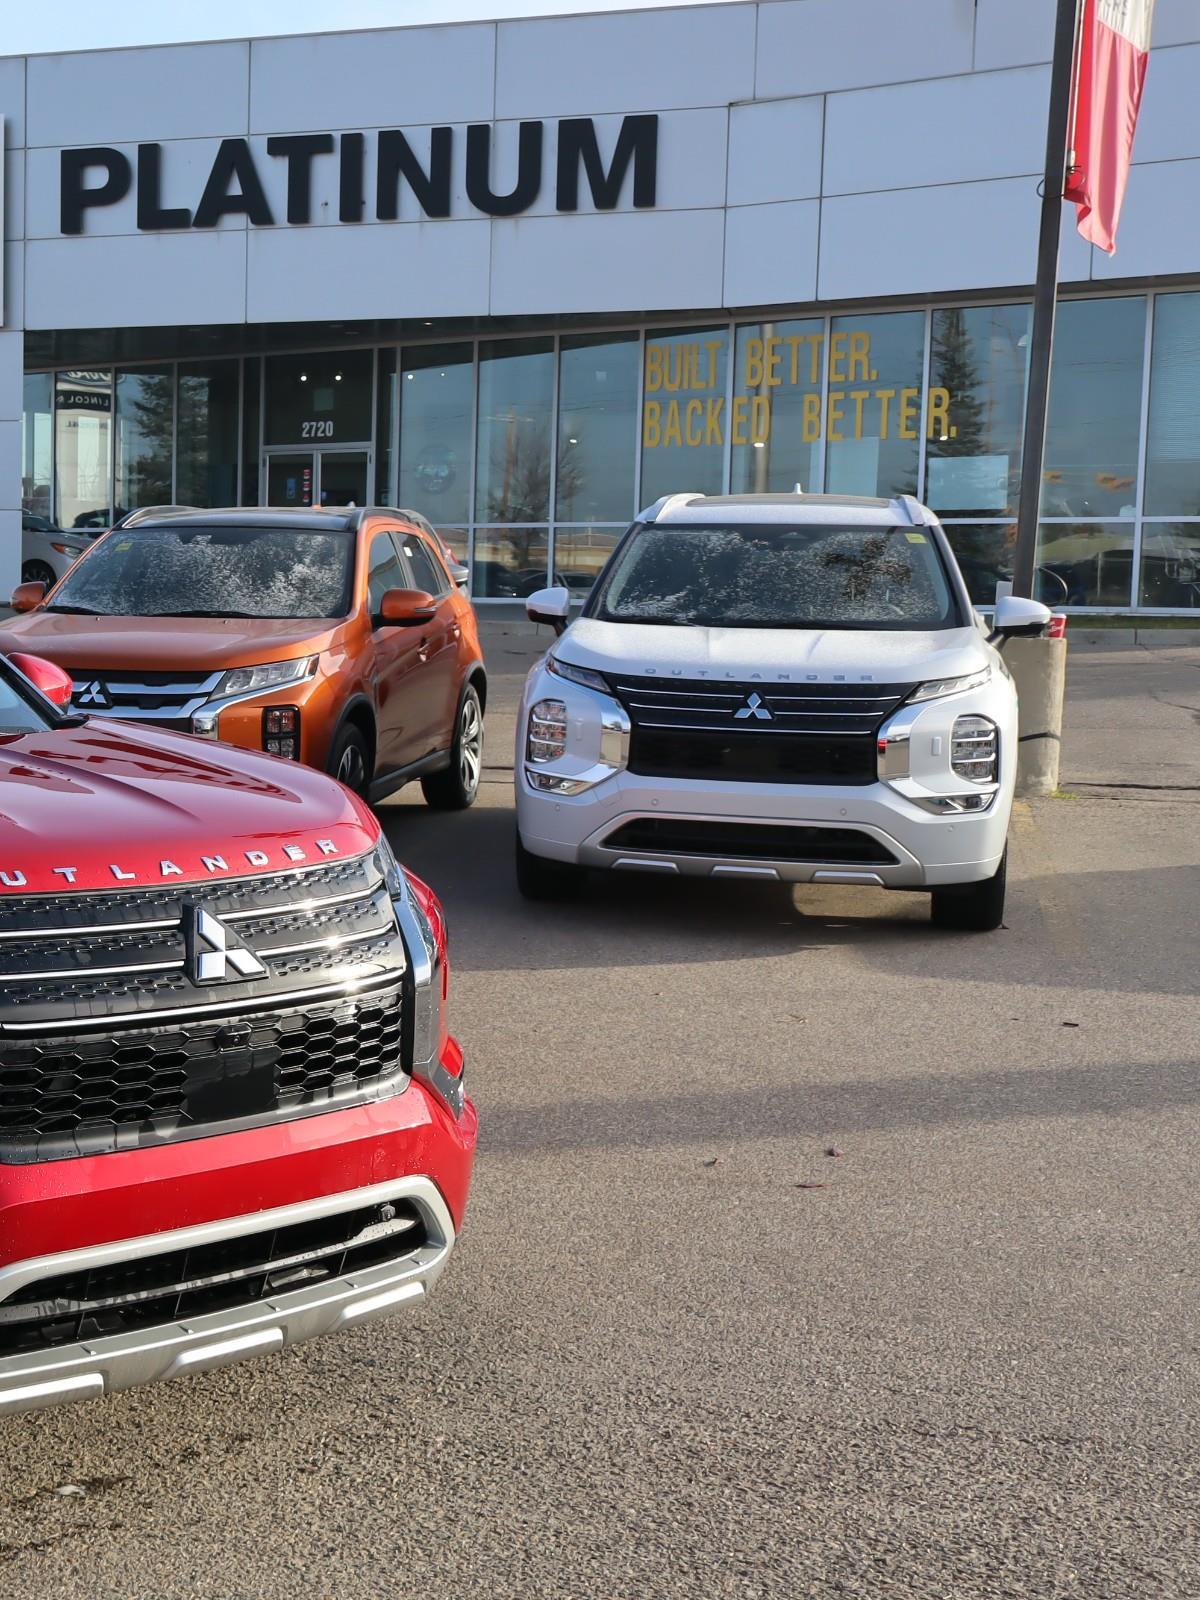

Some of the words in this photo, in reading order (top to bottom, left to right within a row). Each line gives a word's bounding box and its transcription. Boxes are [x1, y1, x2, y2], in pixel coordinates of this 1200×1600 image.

[60, 114, 659, 235] PLATINUM
[646, 340, 725, 392] BUILT
[745, 332, 878, 388] BETTER.
[302, 421, 334, 438] 2720
[643, 395, 772, 448] BACKED
[802, 387, 957, 442] BETTER.
[645, 668, 873, 681] OUTLANDER
